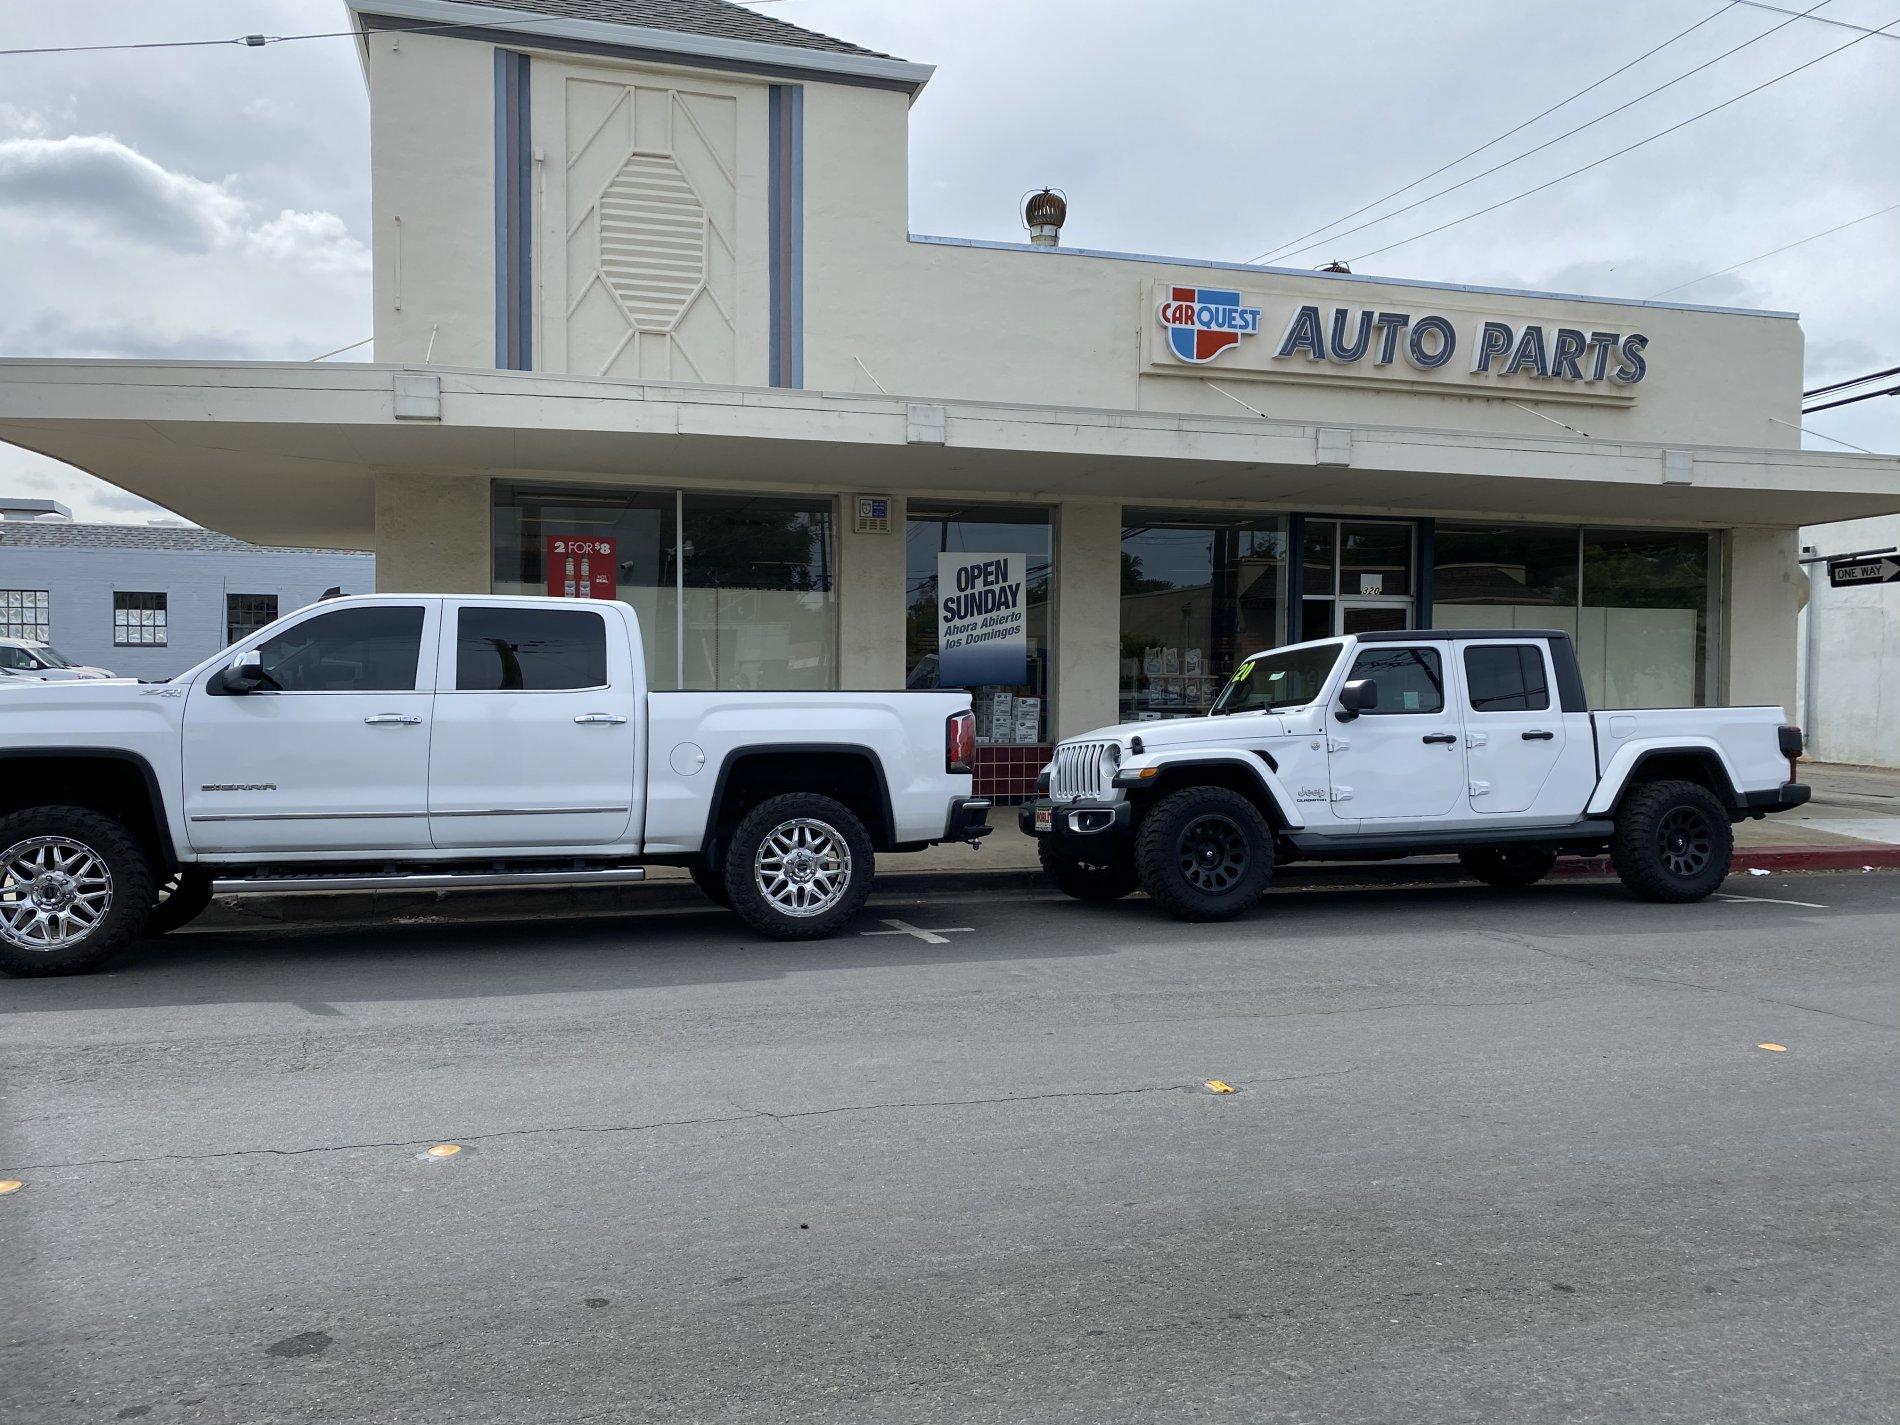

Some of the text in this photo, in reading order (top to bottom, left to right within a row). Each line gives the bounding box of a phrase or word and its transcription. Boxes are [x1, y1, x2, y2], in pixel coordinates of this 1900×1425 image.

[1161, 302, 1261, 331] CARQUEST
[1273, 305, 1650, 387] AUTO PARTS
[554, 541, 611, 555] 2 FOR $8
[956, 557, 1009, 593] OPEN
[1837, 565, 1882, 579] ONE WAY
[943, 582, 1022, 623] SUNDAY
[1362, 586, 1381, 596] 320
[944, 611, 1022, 638] Ahora Abierto
[945, 624, 1021, 650] los Domingos
[1231, 660, 1257, 684] 20
[1297, 786, 1327, 799] Jeep
